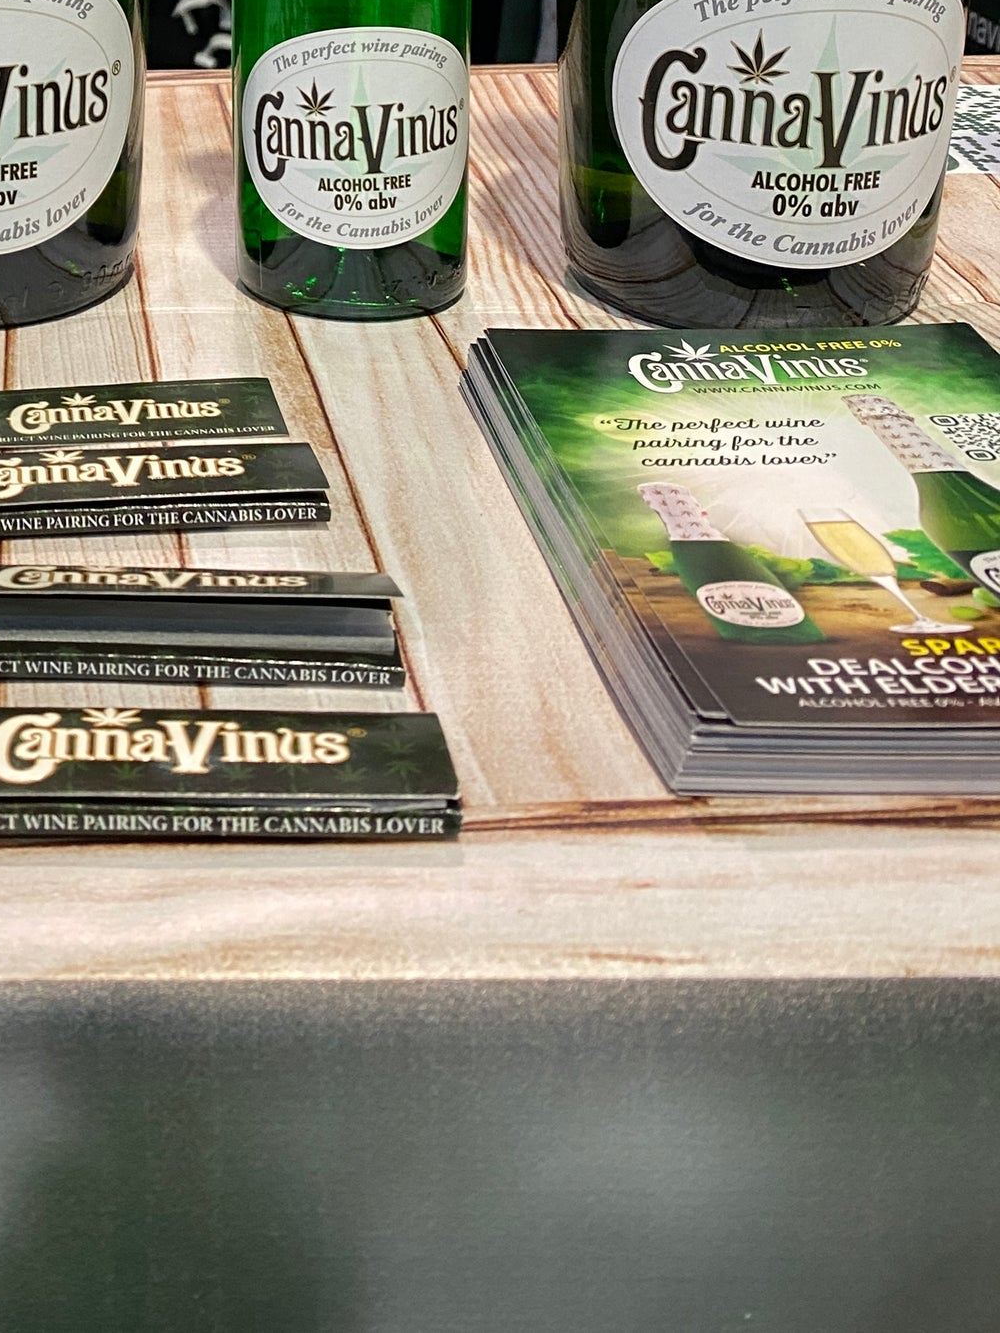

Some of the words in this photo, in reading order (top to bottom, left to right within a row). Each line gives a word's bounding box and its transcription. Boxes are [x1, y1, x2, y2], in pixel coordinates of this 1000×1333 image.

[1, 161, 38, 180] FREE
[318, 177, 380, 192] ALCOHOL
[383, 174, 411, 190] FREE
[751, 171, 839, 192] ALCOHOL
[844, 170, 881, 190] FREE
[46, 186, 87, 227] lover
[334, 194, 362, 211] 0%
[368, 194, 397, 210] abv
[772, 194, 812, 218] 0%
[821, 194, 859, 217] abv
[683, 201, 726, 228] for
[731, 220, 767, 247] the
[773, 228, 876, 256] Cannabis
[881, 198, 918, 240] lover
[719, 343, 814, 353] ALCOHOL
[819, 340, 864, 351] FREE
[870, 339, 901, 348] 0%
[693, 383, 881, 394] WWW.CANNAVINUS.COM
[671, 418, 760, 433] perfect
[765, 418, 824, 429] wine
[633, 436, 727, 451] pairing
[731, 435, 774, 451] for
[777, 435, 819, 447] the
[641, 454, 756, 467] cannabis
[0, 517, 42, 532] WINE
[45, 515, 109, 530] PAIRING
[114, 513, 143, 526] FOR
[147, 511, 179, 525] THE
[182, 509, 263, 524] CANNABIS
[266, 507, 317, 521] LOVER
[807, 657, 1000, 676] DEALCOH
[755, 677, 870, 695] WITH
[875, 676, 1000, 695] ELDER
[25, 814, 79, 833] WINE
[83, 815, 168, 833] PAIRING
[172, 815, 212, 834] FOR
[217, 816, 260, 834] THE
[263, 816, 371, 834] CANNABIS
[375, 816, 444, 835] LOVER
